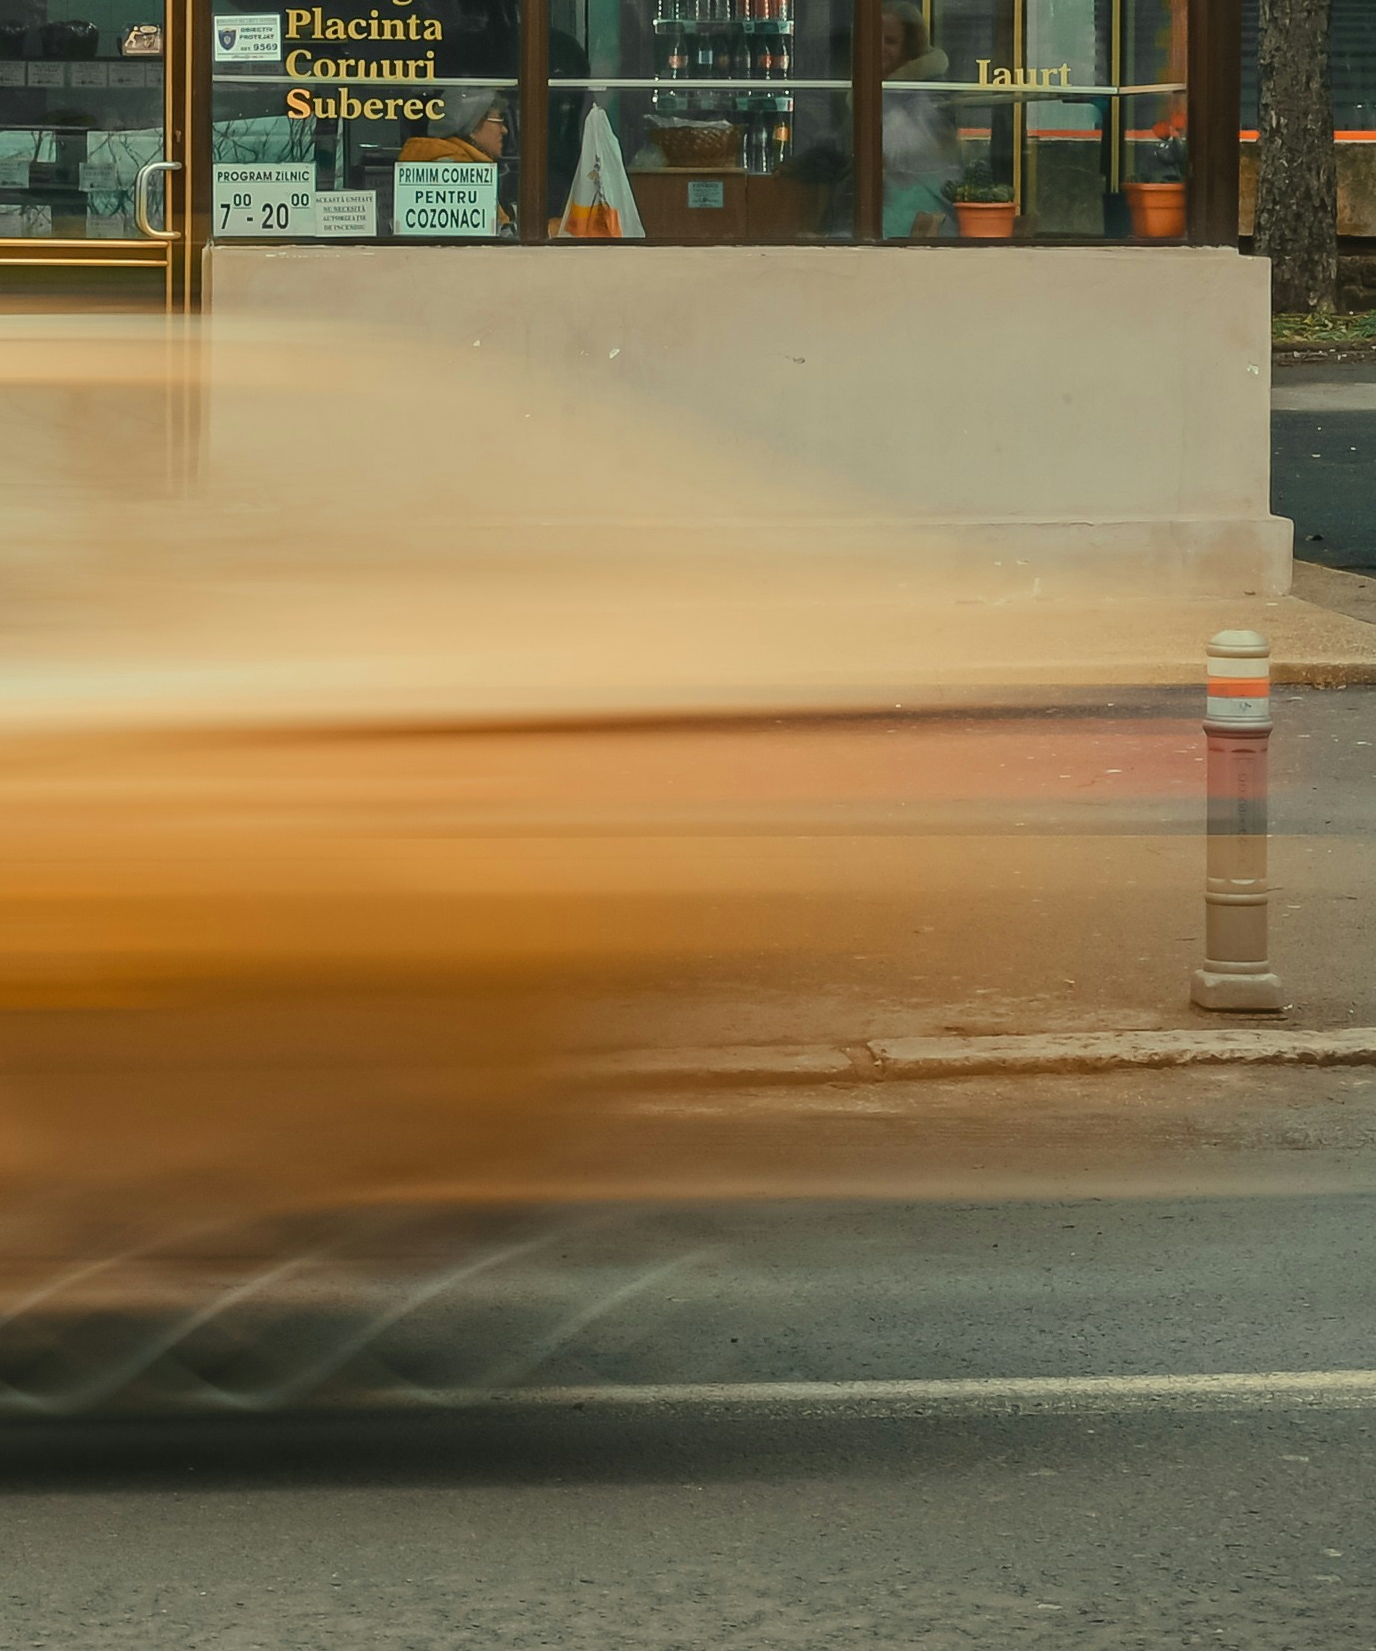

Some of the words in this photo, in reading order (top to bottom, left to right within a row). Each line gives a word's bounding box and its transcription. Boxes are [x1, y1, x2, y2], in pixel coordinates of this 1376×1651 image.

[285, 8, 443, 40] Placinta
[285, 49, 435, 80] Cornuri
[976, 59, 1072, 89] Iaurt
[286, 87, 446, 120] Suberec
[217, 171, 272, 182] PROGRAM
[275, 171, 310, 181] ZILNIC
[399, 168, 439, 183] PRIMIM
[441, 168, 493, 183] COMENZI
[415, 190, 477, 204] PENTRU
[405, 208, 485, 229] COZONACI
